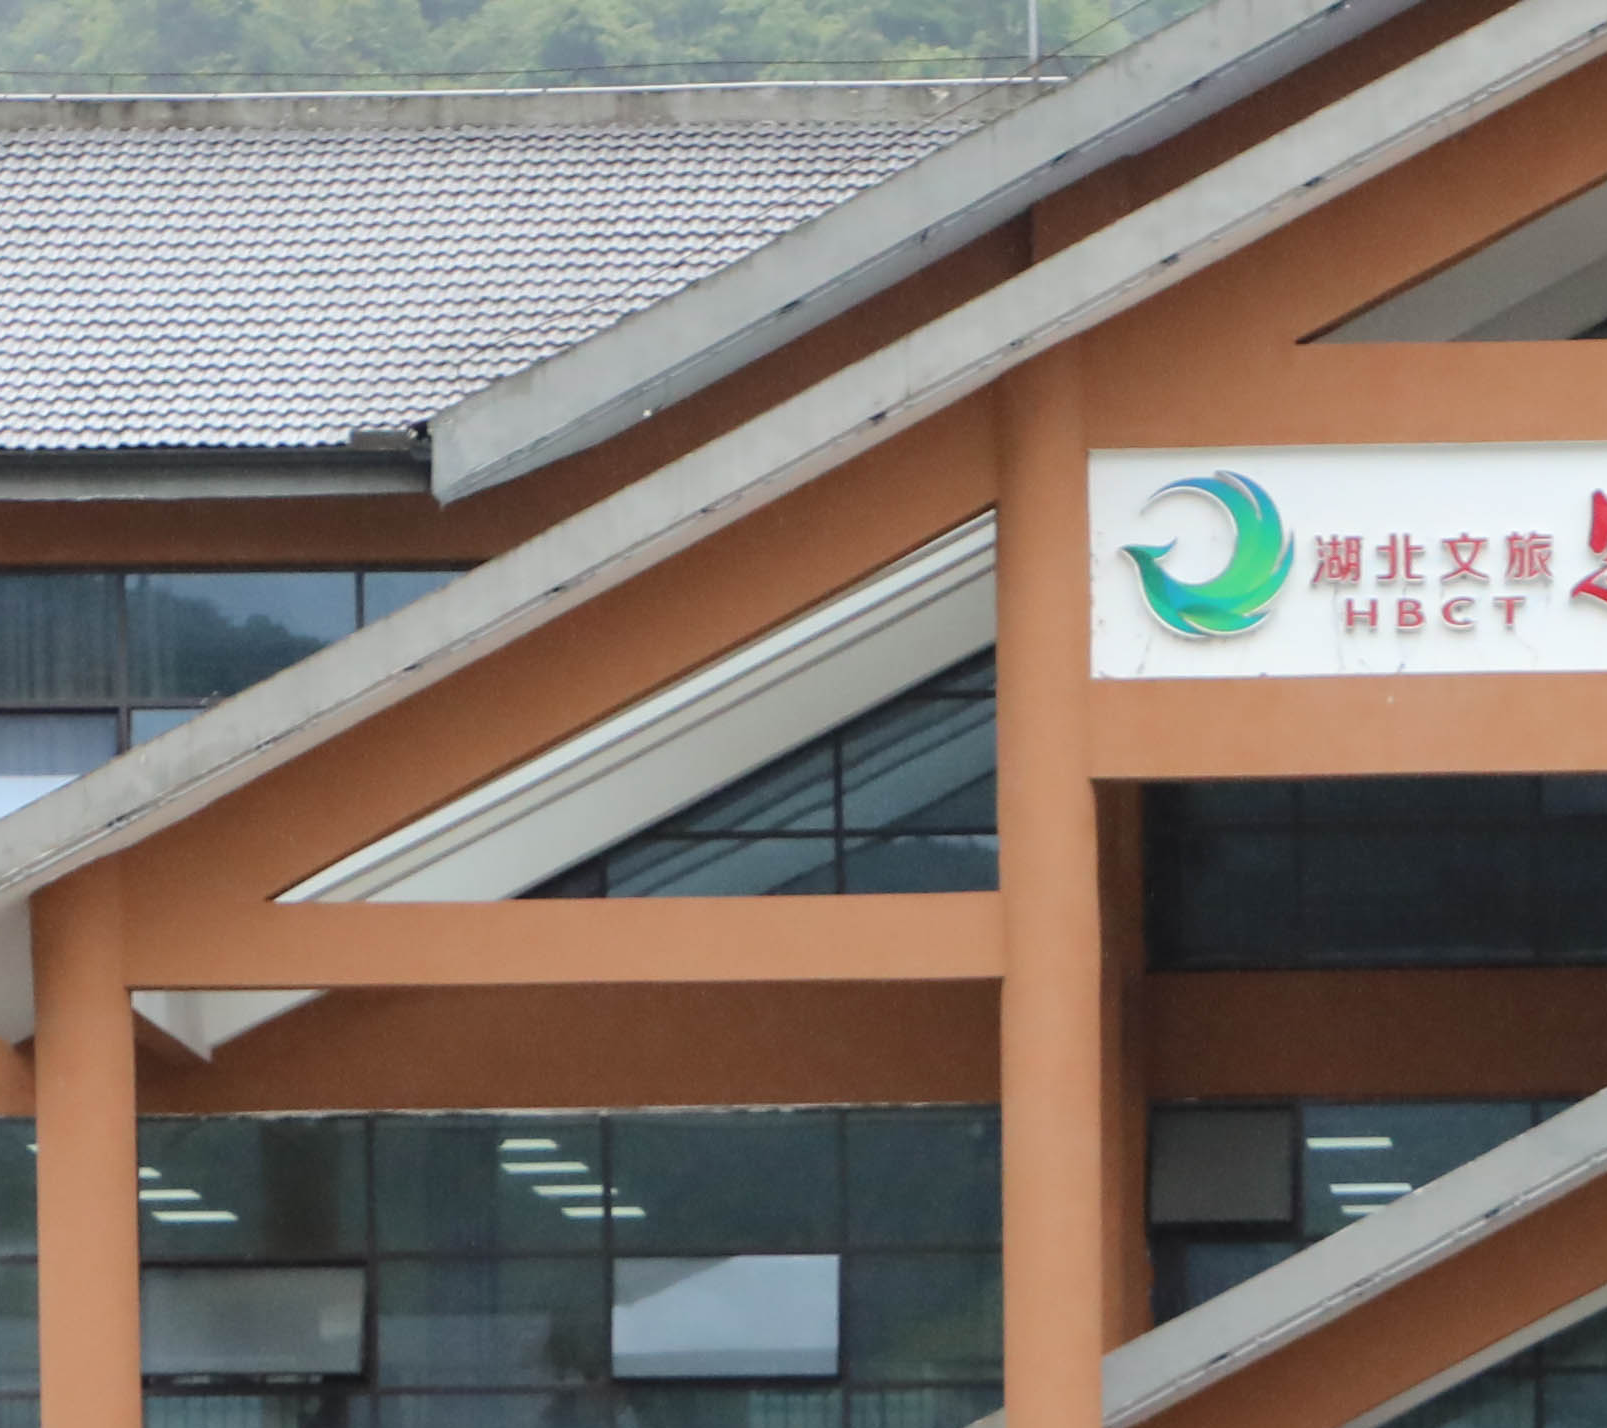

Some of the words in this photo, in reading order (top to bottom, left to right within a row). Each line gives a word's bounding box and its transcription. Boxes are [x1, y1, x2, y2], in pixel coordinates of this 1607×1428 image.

[1312, 532, 1553, 584] 湖北文旅
[1346, 597, 1526, 629] HBCT
